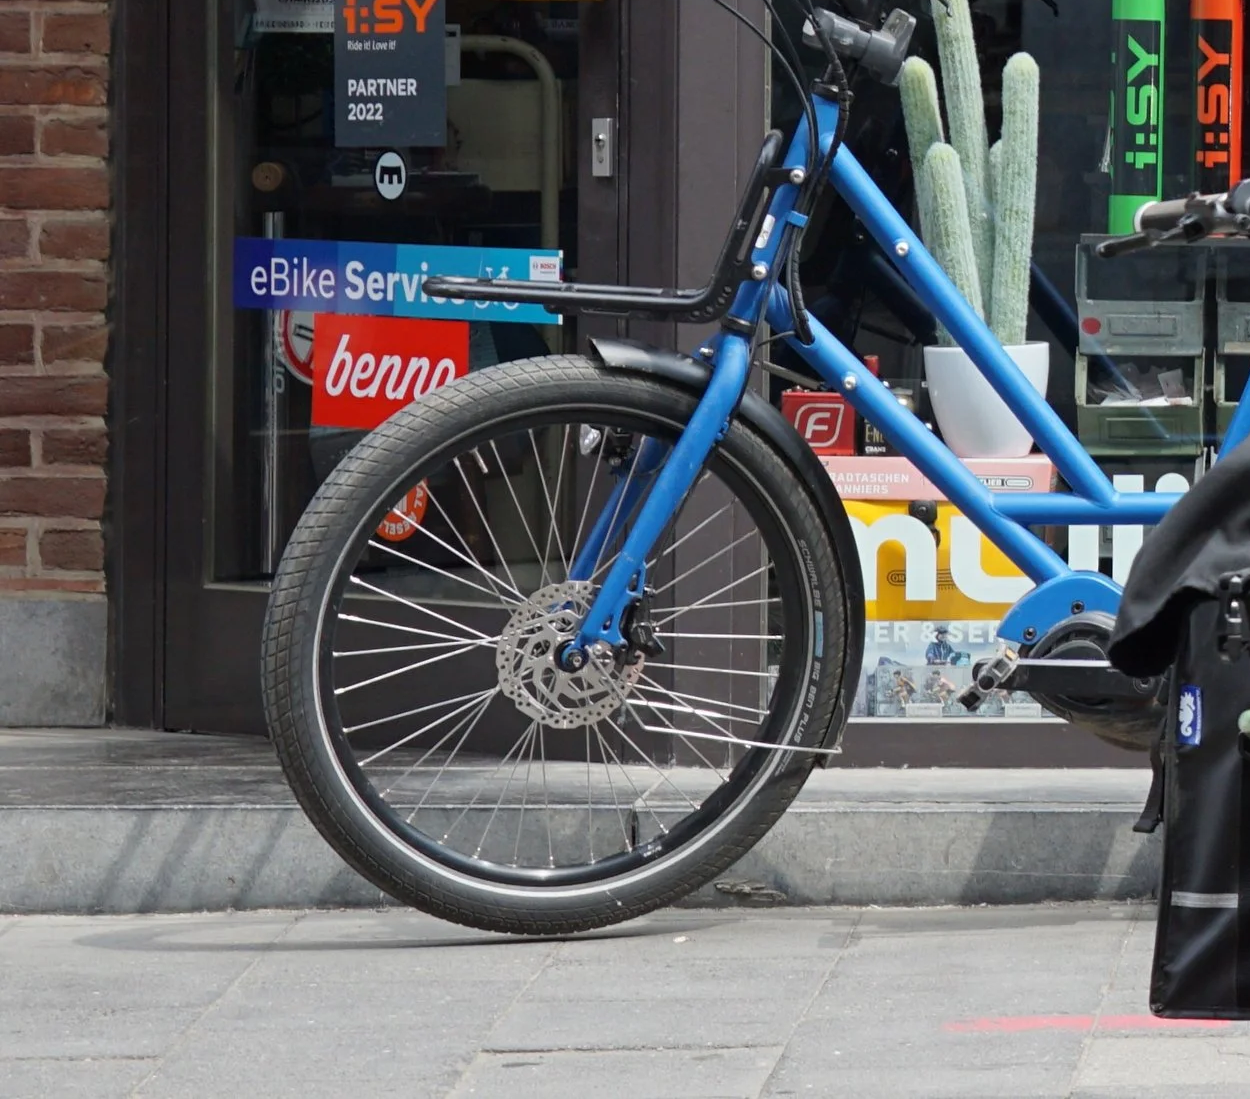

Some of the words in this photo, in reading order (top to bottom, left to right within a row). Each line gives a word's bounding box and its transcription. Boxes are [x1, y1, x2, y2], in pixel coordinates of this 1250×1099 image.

[347, 40, 363, 51] Ride
[372, 40, 388, 51] Love
[347, 78, 418, 97] PARTNER
[1125, 33, 1159, 170] i:SY
[1196, 34, 1231, 169] i:SY
[347, 103, 384, 121] 2022
[250, 256, 336, 299] eBike
[344, 260, 466, 305] Servi
[325, 333, 456, 401] benno
[814, 661, 822, 682] BIG
[793, 713, 810, 744] PLUS
